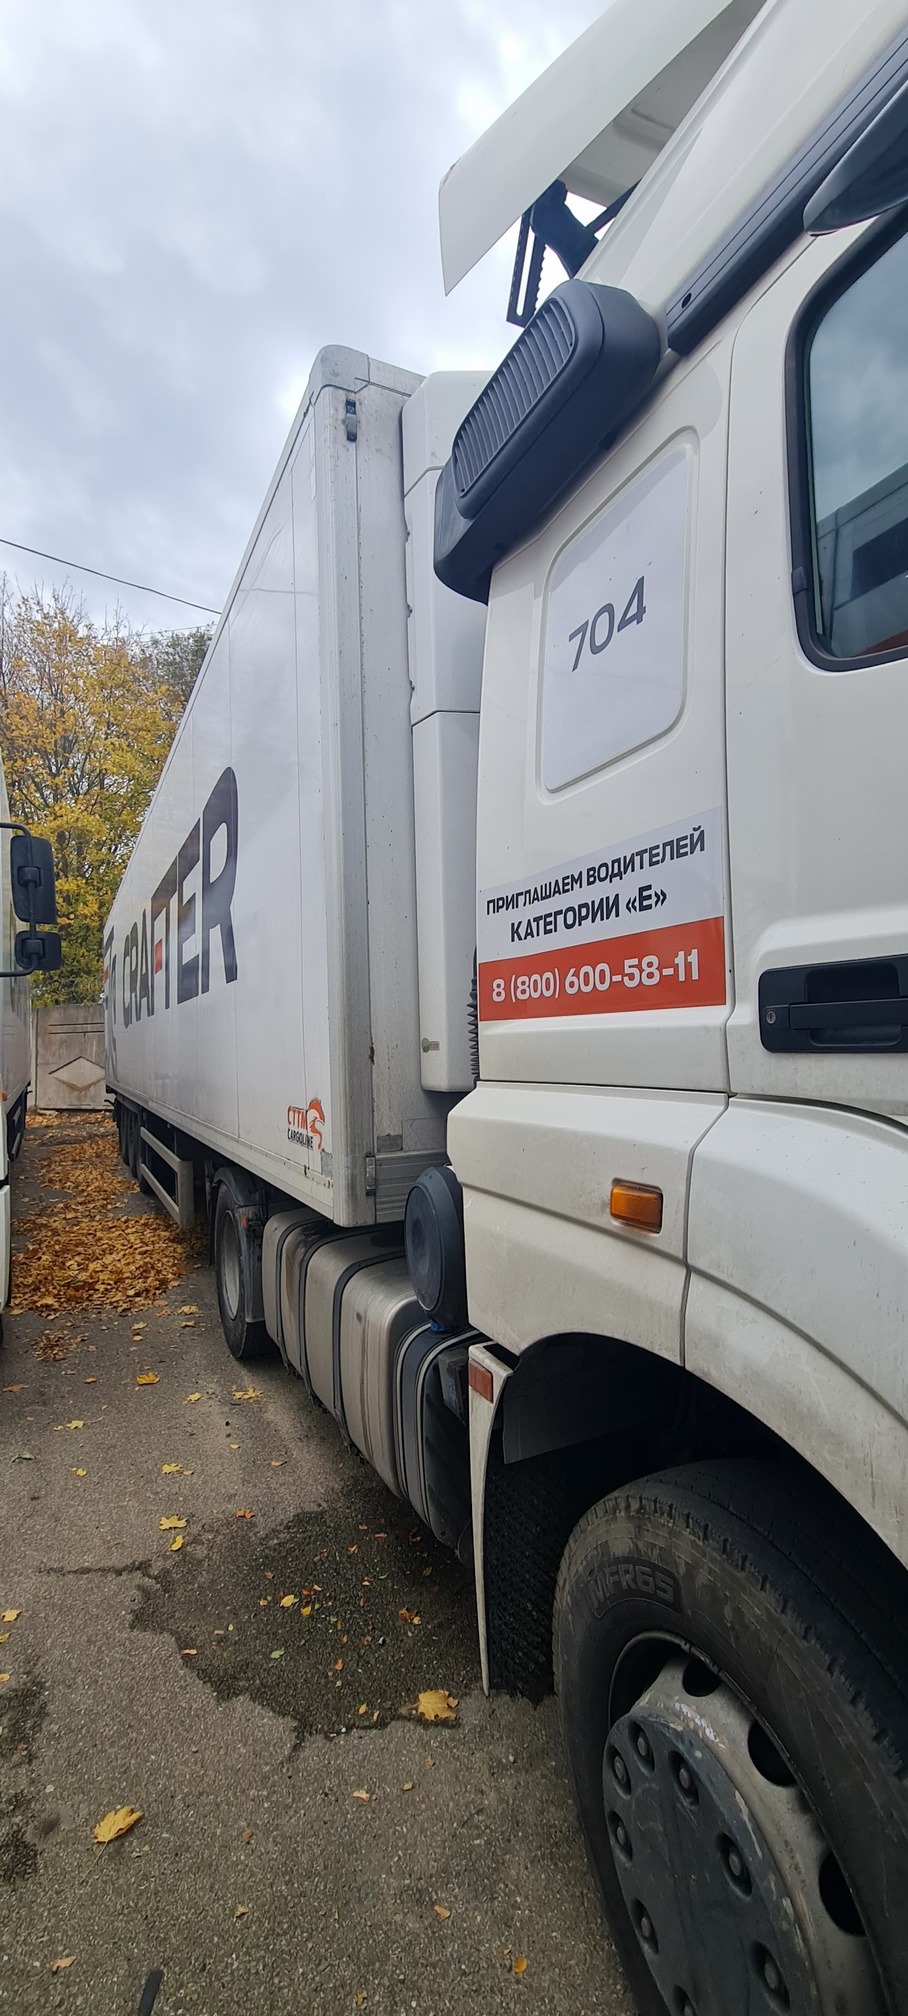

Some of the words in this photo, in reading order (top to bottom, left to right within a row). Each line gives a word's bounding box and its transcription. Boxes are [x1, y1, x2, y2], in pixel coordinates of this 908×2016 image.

[568, 576, 647, 672] 704
[122, 766, 238, 1029] CRAFTER
[486, 870, 583, 915] ПРИГЛАШАЕМ
[586, 825, 705, 886] ВОДИТЕЛЕЙ
[510, 893, 620, 942] КАТЕГОРИИ
[492, 978, 506, 1002] 8
[510, 967, 560, 1003] (800)
[564, 948, 699, 995] 600-58-11
